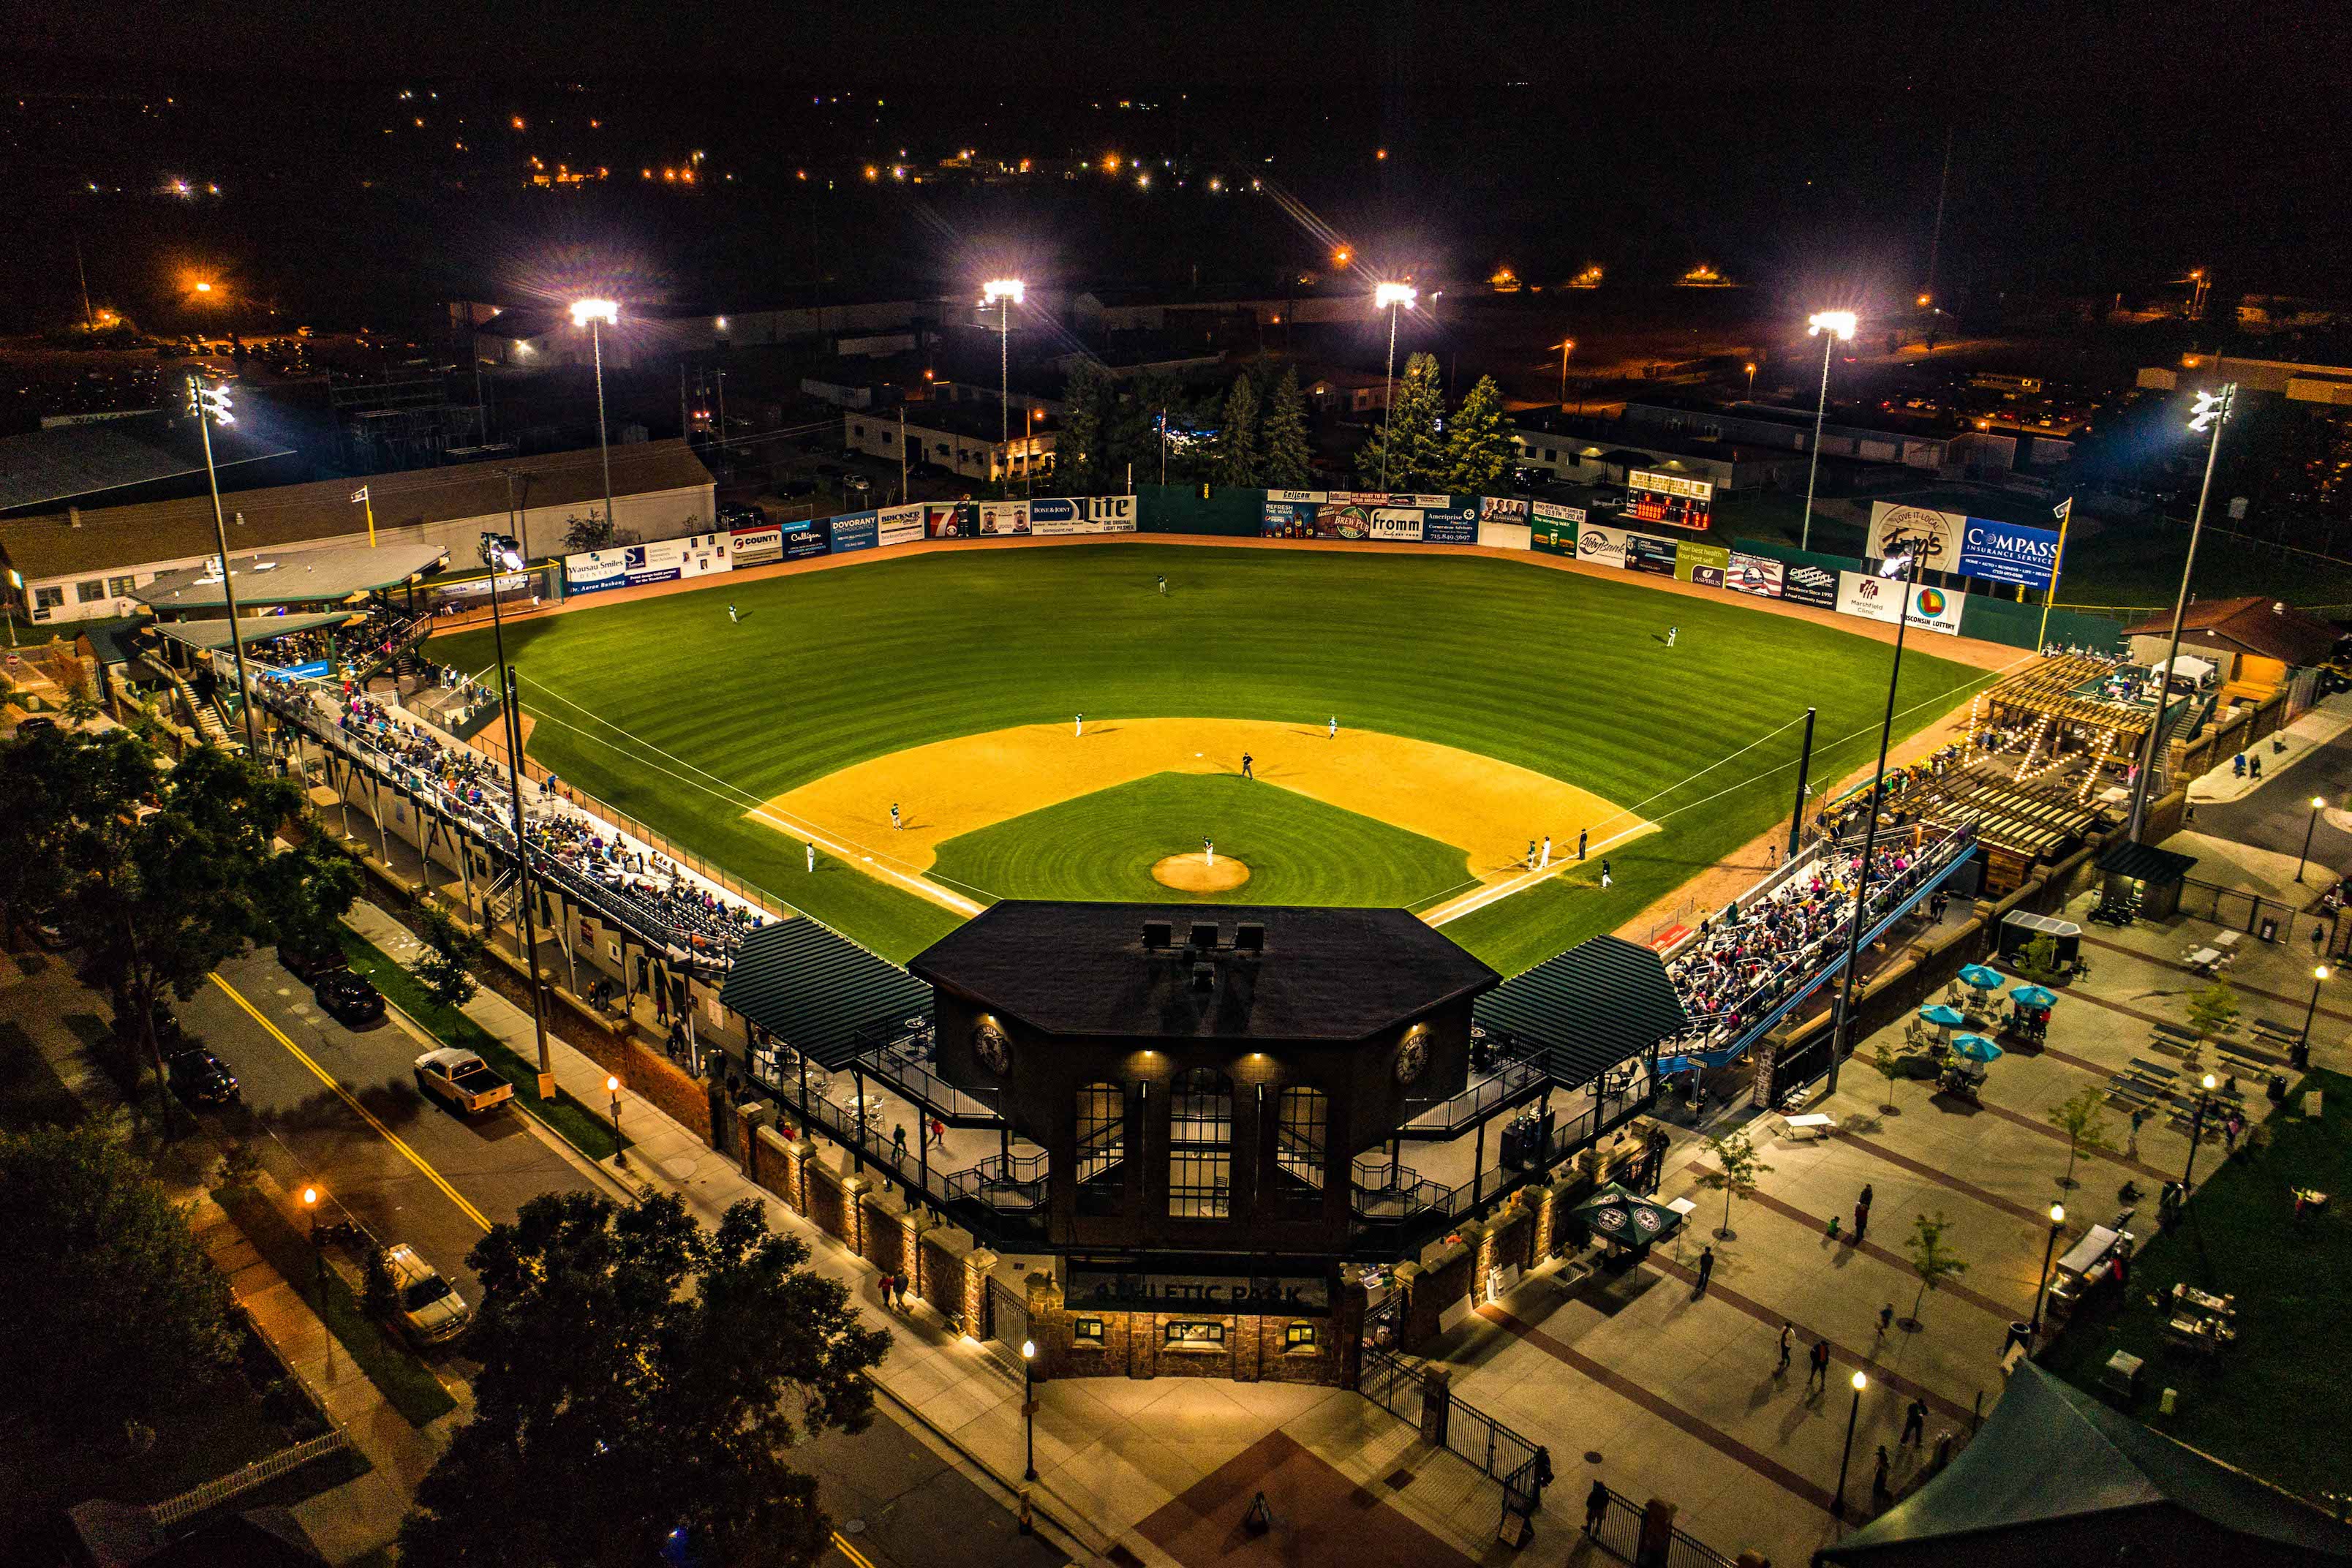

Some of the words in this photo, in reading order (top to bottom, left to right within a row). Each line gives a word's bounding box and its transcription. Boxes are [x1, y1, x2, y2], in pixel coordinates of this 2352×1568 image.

[1631, 479, 1688, 495] WOODCHUCKS
[1635, 474, 1685, 488] WISCONSIN
[1283, 491, 1311, 500] Cellcom
[881, 511, 920, 522] BRICKNER
[1083, 497, 1129, 524] Lite
[832, 516, 876, 529] DOVORANY
[932, 506, 954, 537] 7
[1373, 512, 1419, 531] fromm
[1493, 513, 1524, 522] TEAMWORK!
[1894, 512, 1912, 524] LOVE
[1921, 513, 1940, 532] LOCAL
[834, 524, 875, 534] ORTHODONTICS
[1334, 516, 1354, 525] BREW
[1355, 520, 1370, 532] PUB
[791, 532, 821, 542] Culligan
[1341, 529, 1358, 537] PIZZA
[745, 535, 778, 545] COUNTY
[1579, 536, 1625, 554] AbbyBank
[1967, 528, 2059, 559] COMPASS
[1692, 546, 1703, 554] best
[1704, 548, 1723, 557] health.
[1967, 544, 2014, 558] INSURANCE
[2017, 554, 2056, 565] SERVICE
[1691, 554, 1703, 562] best
[1703, 557, 1714, 565] self.
[569, 564, 598, 573] Wausau
[600, 560, 623, 569] Smiles
[1998, 564, 2019, 573] BUSINESS
[580, 569, 614, 579] DENTAL
[1789, 568, 1833, 583] CRYSTAL
[581, 584, 599, 592] Aaron
[600, 580, 625, 588] Bushong
[1694, 576, 1721, 586] ASPIRUS
[1786, 585, 1809, 594] Excellence
[2016, 584, 2026, 603] 316
[1797, 595, 1815, 603] Community
[1850, 599, 1883, 611] Marshfield
[1857, 607, 1874, 615] Clinic
[1901, 614, 1931, 626] ISCONSIN
[1932, 620, 1956, 630] LOTTERY
[1232, 1285, 1303, 1305] PARK
